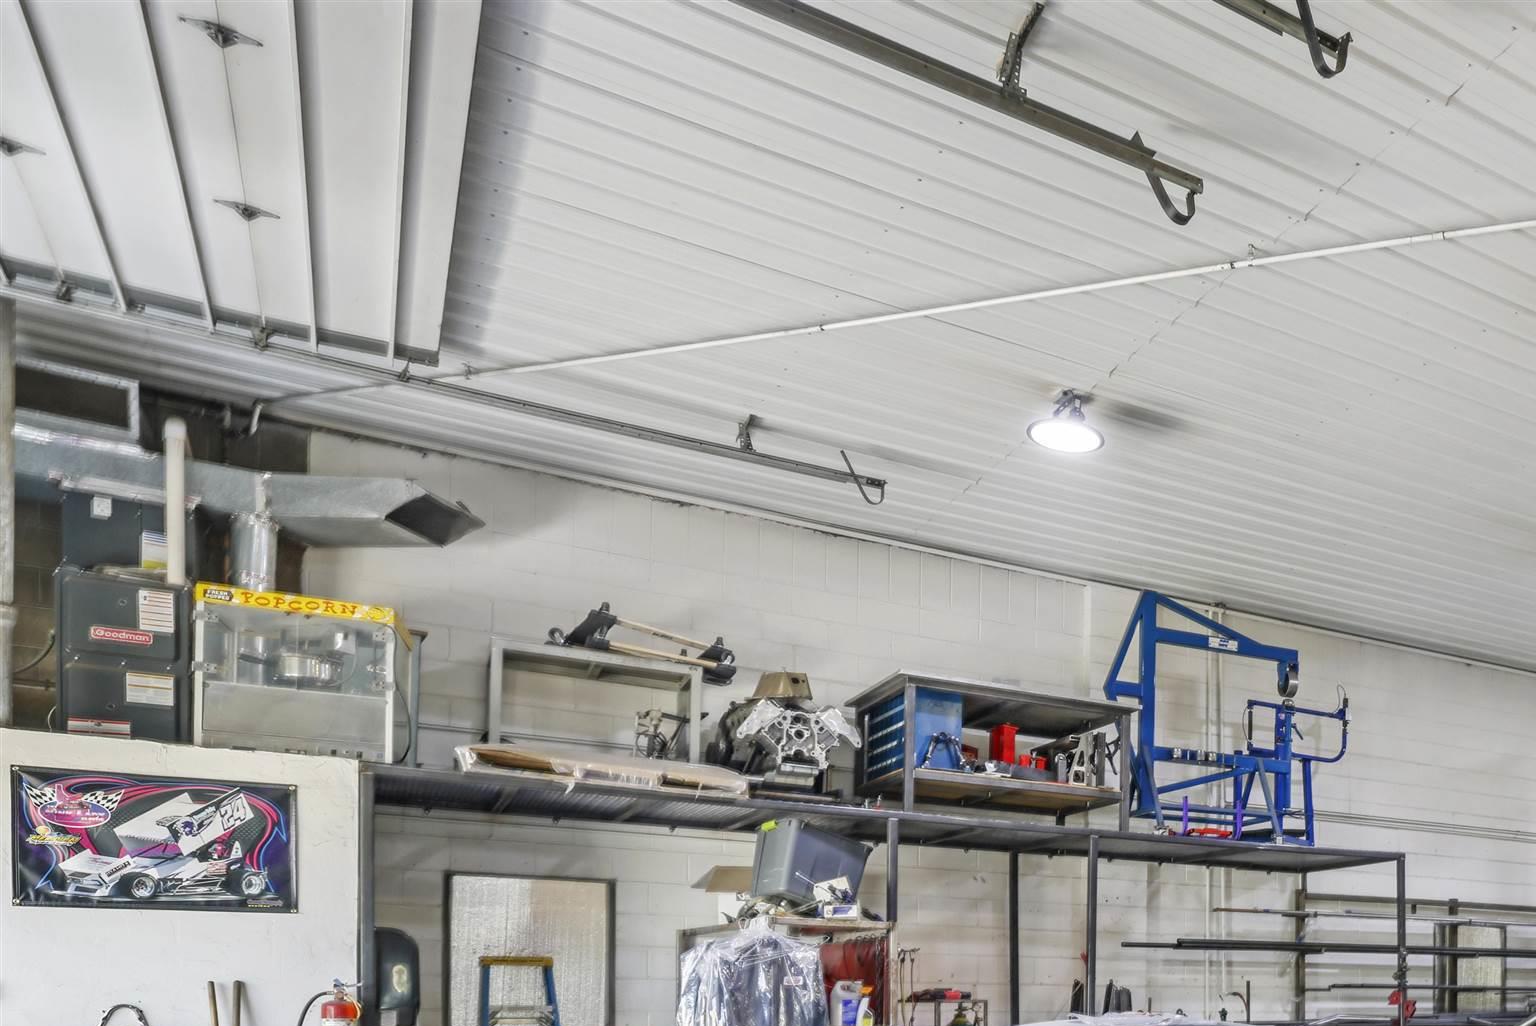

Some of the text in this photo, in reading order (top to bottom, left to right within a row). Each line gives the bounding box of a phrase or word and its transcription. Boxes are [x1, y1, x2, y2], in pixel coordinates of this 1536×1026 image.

[241, 591, 357, 616] POPCORN
[94, 628, 151, 643] Goodman
[219, 796, 247, 831] 24
